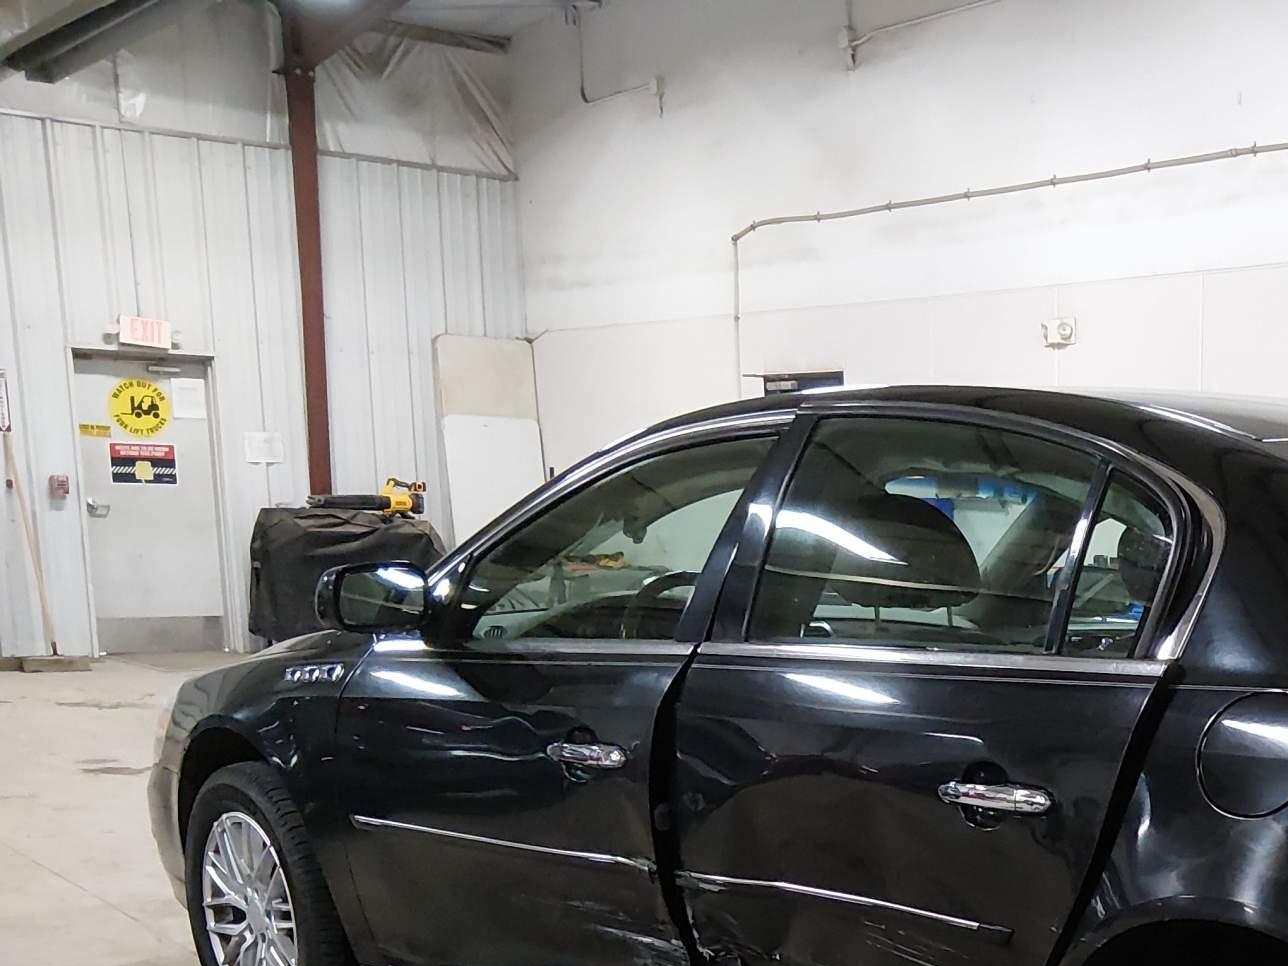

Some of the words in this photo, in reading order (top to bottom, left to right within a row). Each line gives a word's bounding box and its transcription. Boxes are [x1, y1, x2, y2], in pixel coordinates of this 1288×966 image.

[130, 318, 163, 344] EXIT
[112, 381, 134, 399] WATCH
[136, 380, 151, 390] OUT
[152, 387, 166, 402] FOR
[113, 414, 128, 430] FORK
[129, 427, 144, 435] LIFT
[146, 417, 167, 435] TRUCKS
